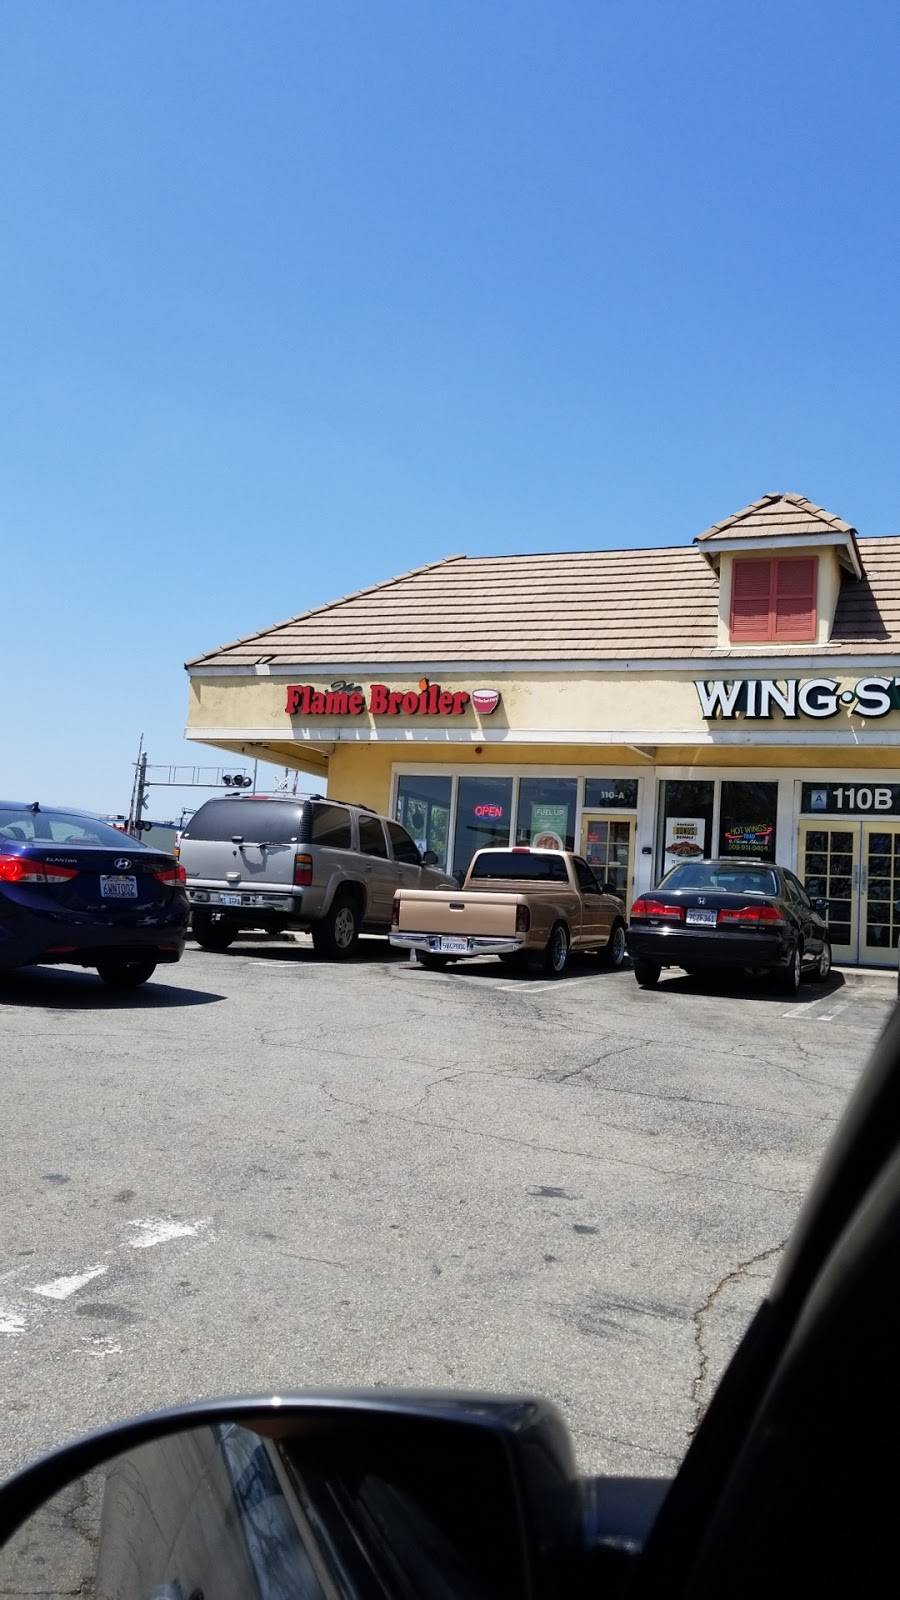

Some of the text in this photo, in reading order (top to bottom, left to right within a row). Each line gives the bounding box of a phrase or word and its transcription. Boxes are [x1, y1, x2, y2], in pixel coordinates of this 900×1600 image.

[285, 677, 470, 714] Flame Broiler
[601, 791, 625, 799] 110-A
[815, 794, 823, 802] A
[832, 787, 893, 809] 110B
[474, 805, 503, 817] OPEN
[536, 808, 552, 816] FUEL
[730, 823, 767, 834] HOT WINGS
